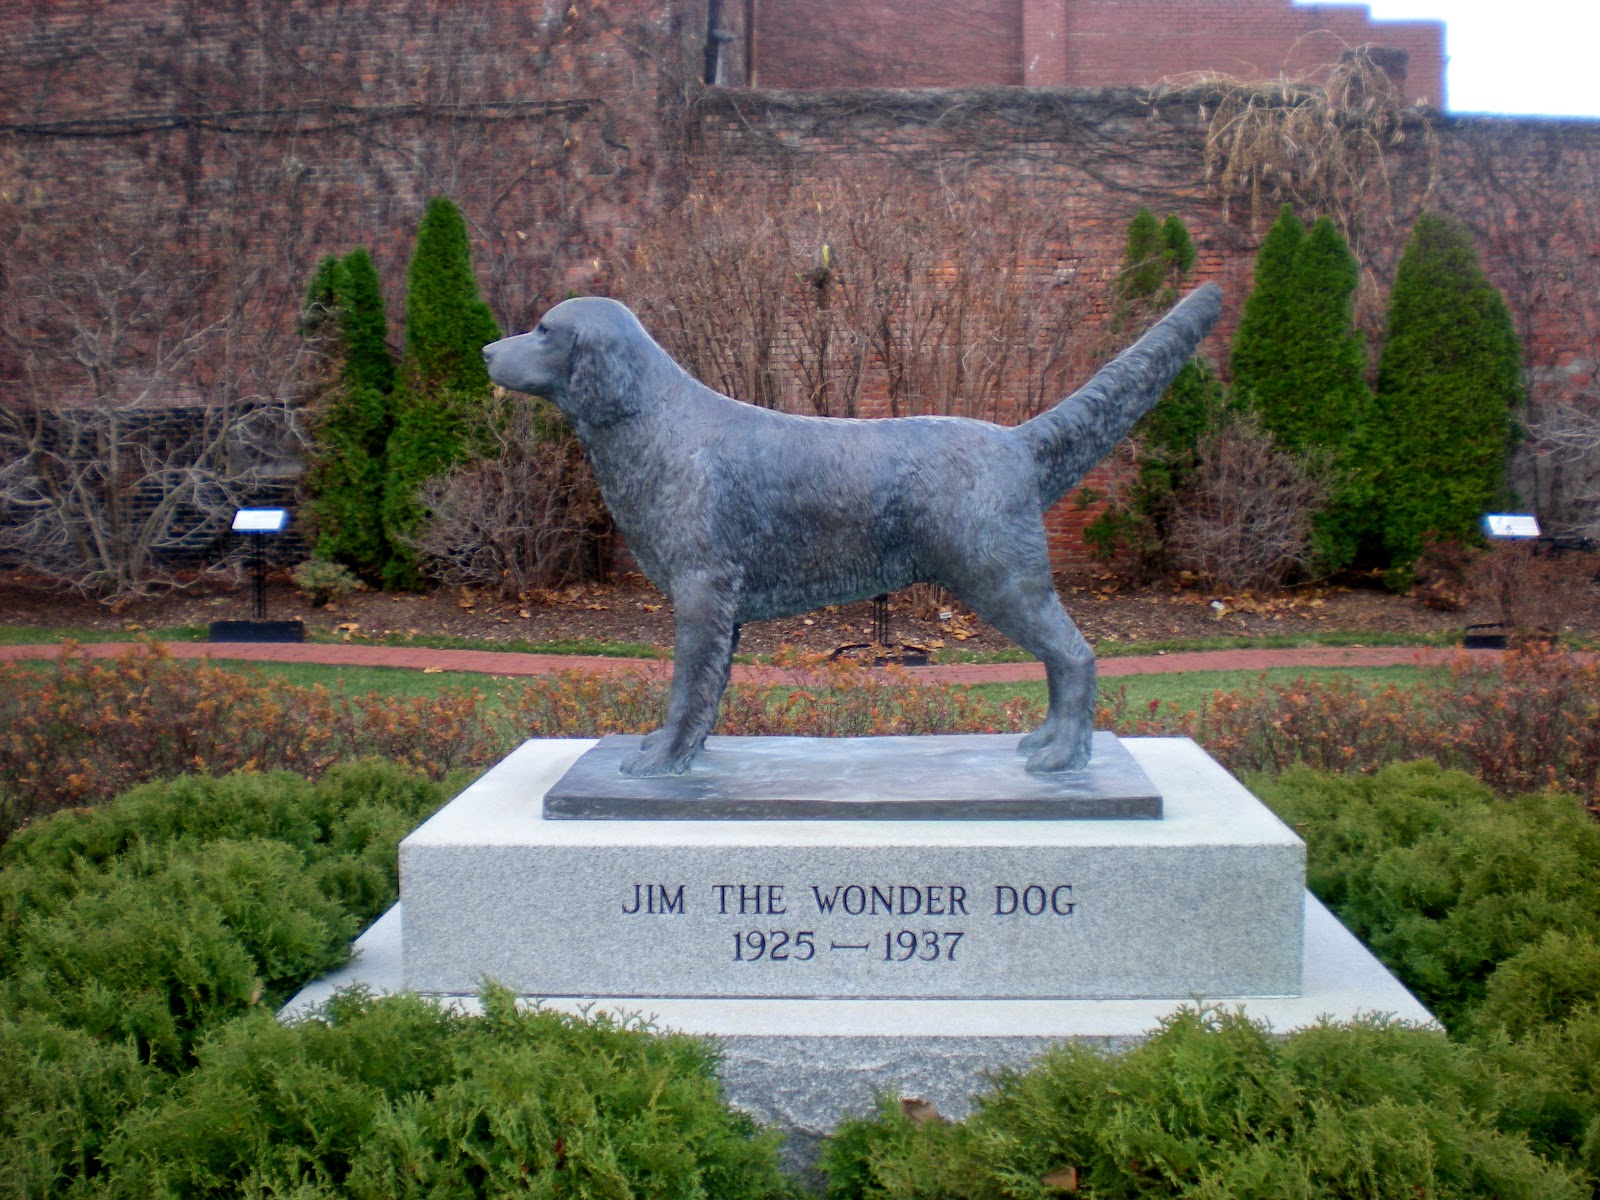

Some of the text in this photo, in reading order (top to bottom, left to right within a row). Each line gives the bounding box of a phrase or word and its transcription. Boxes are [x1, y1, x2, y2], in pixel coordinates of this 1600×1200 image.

[621, 884, 1077, 916] JIM THE WONDER DOG
[733, 930, 815, 962] 1925
[884, 930, 965, 962] 1937
